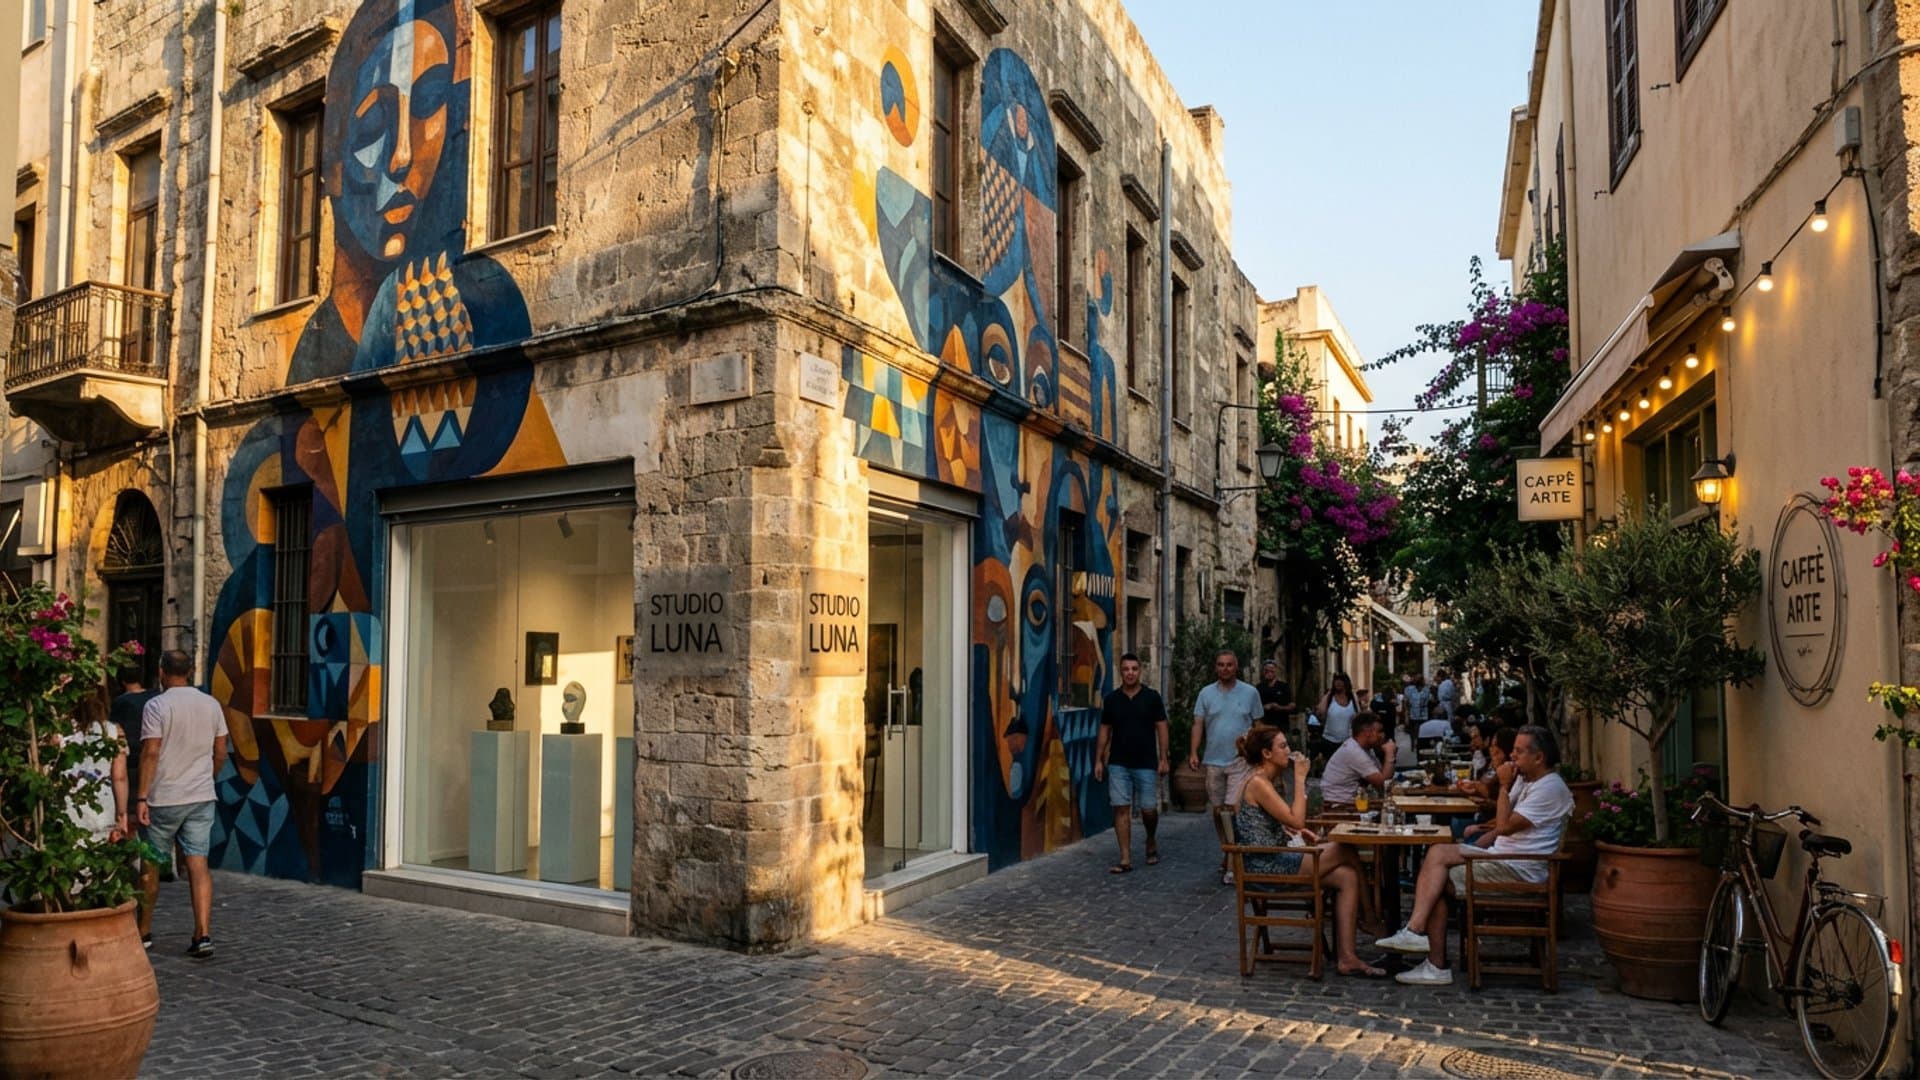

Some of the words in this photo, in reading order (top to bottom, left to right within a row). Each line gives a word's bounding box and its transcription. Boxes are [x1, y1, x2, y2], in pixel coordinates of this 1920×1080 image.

[1530, 491, 1571, 504] ARTE
[651, 592, 724, 616] STUDIO
[809, 593, 861, 617] STUDIO
[1786, 592, 1822, 624] ARTE
[651, 623, 723, 652] LUNA
[809, 624, 859, 653] LUNA
